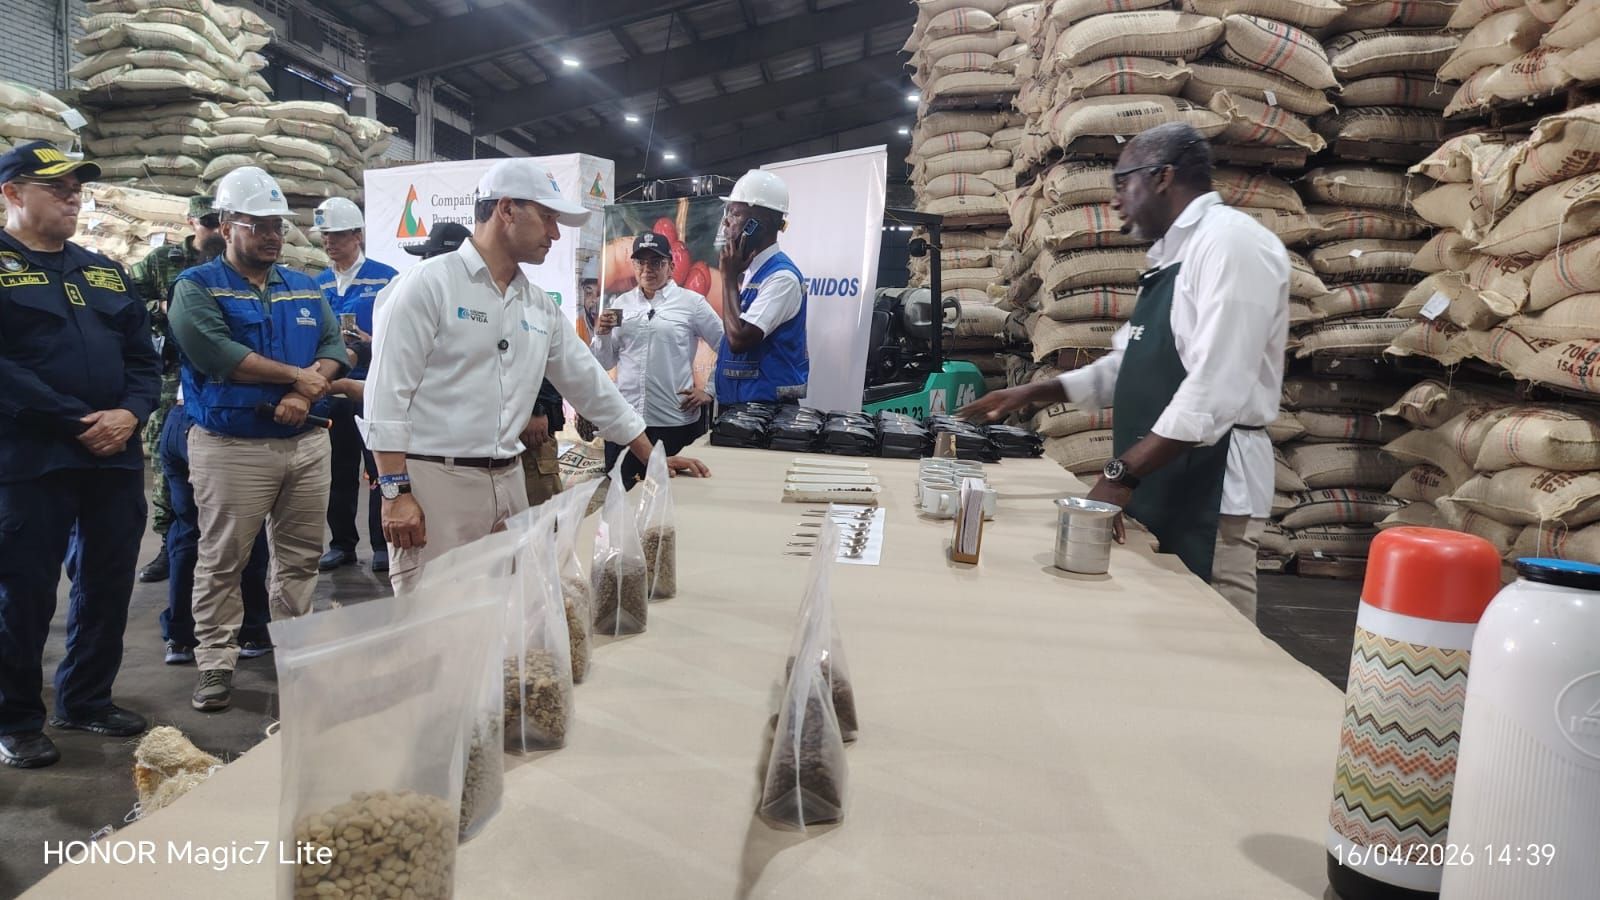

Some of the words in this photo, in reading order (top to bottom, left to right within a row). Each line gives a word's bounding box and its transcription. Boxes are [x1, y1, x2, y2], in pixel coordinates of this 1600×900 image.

[431, 193, 474, 210] Compañí
[470, 315, 489, 323] VIDA
[912, 406, 923, 421] 23
